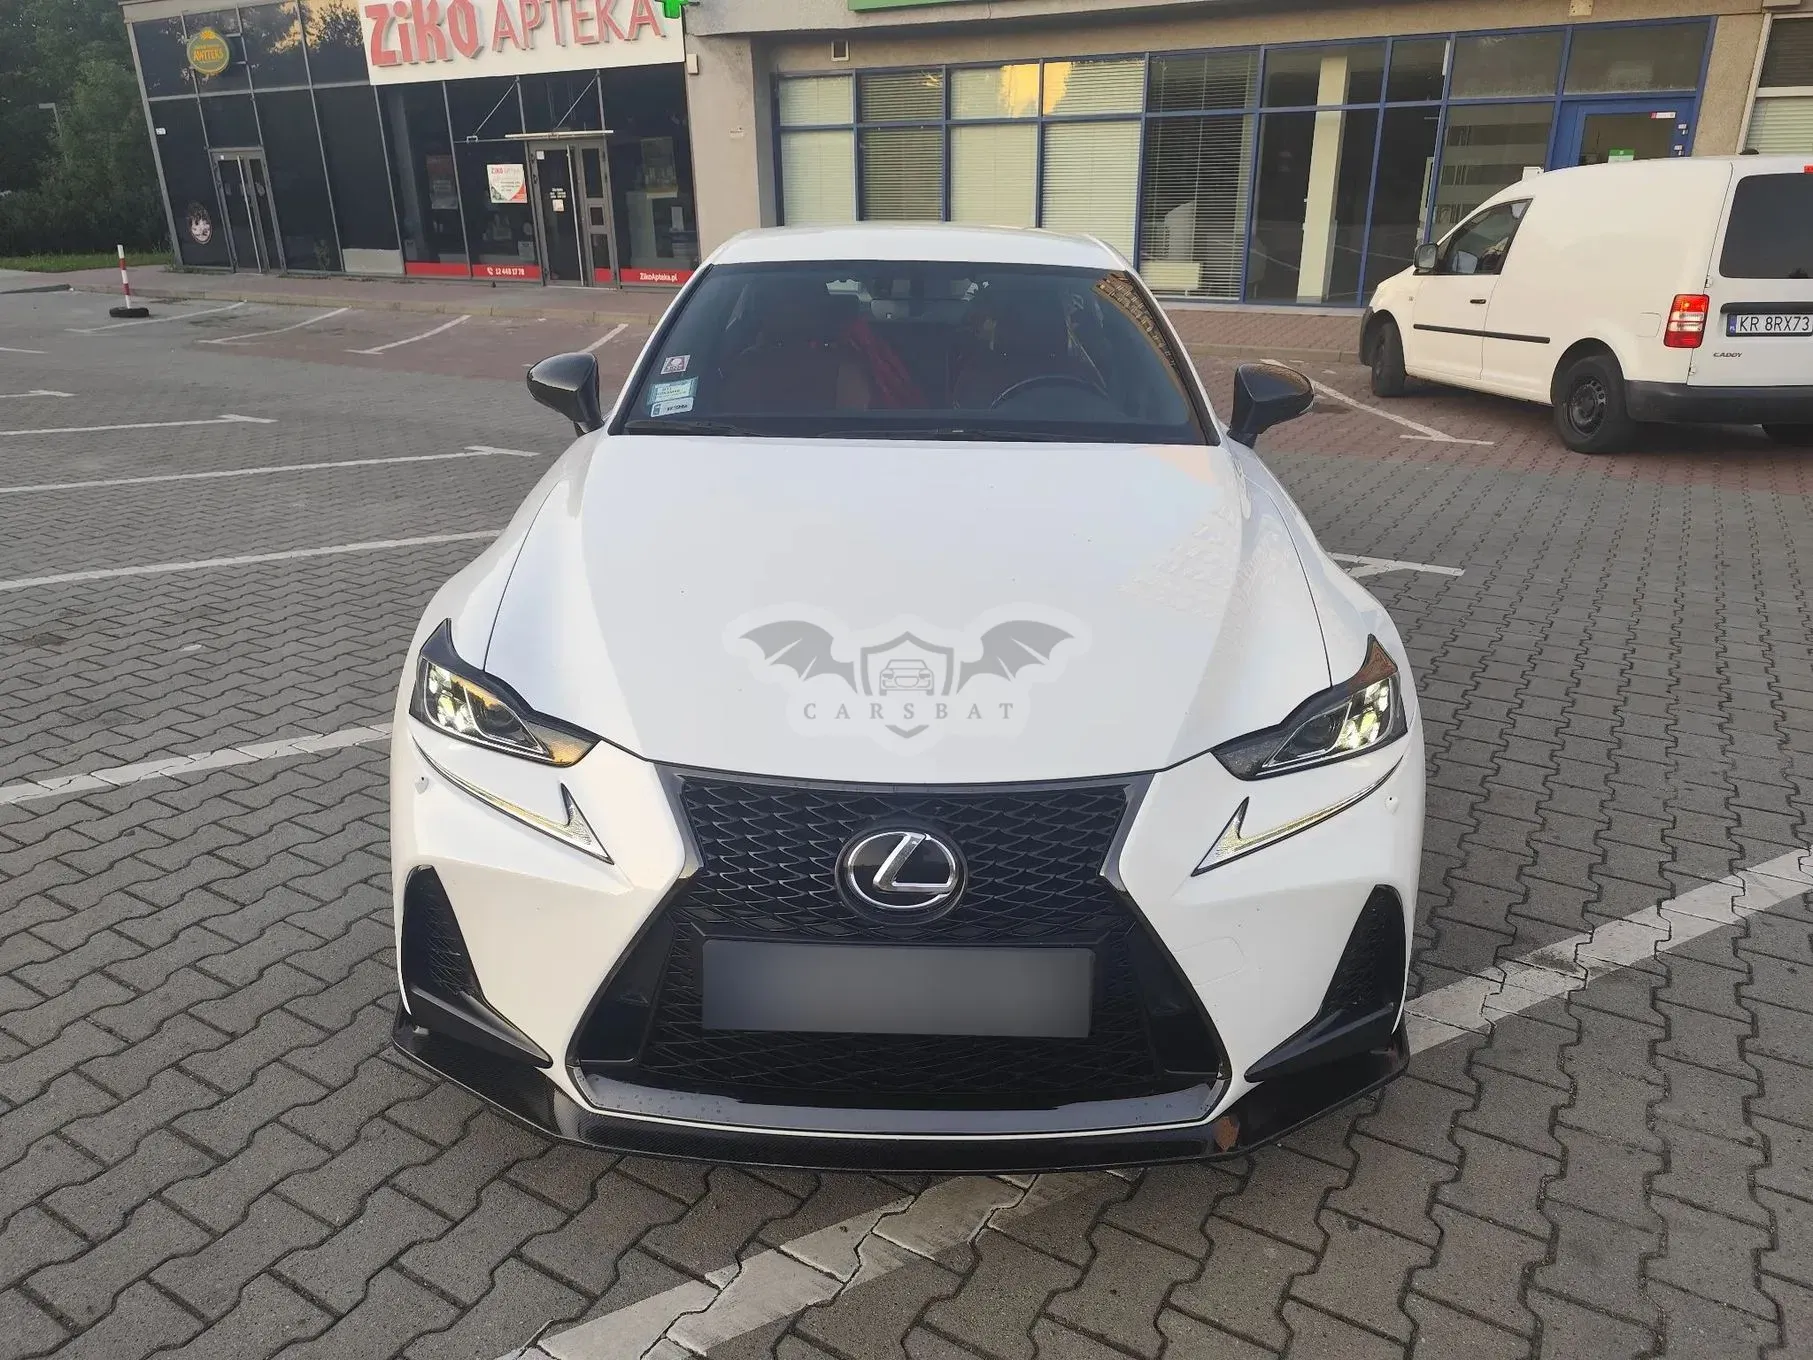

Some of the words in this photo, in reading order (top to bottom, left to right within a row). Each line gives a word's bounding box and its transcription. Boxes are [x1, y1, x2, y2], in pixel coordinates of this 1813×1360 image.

[492, 0, 665, 52] APTEKA
[1739, 316, 1760, 332] KR
[1764, 316, 1810, 332] 8RX73
